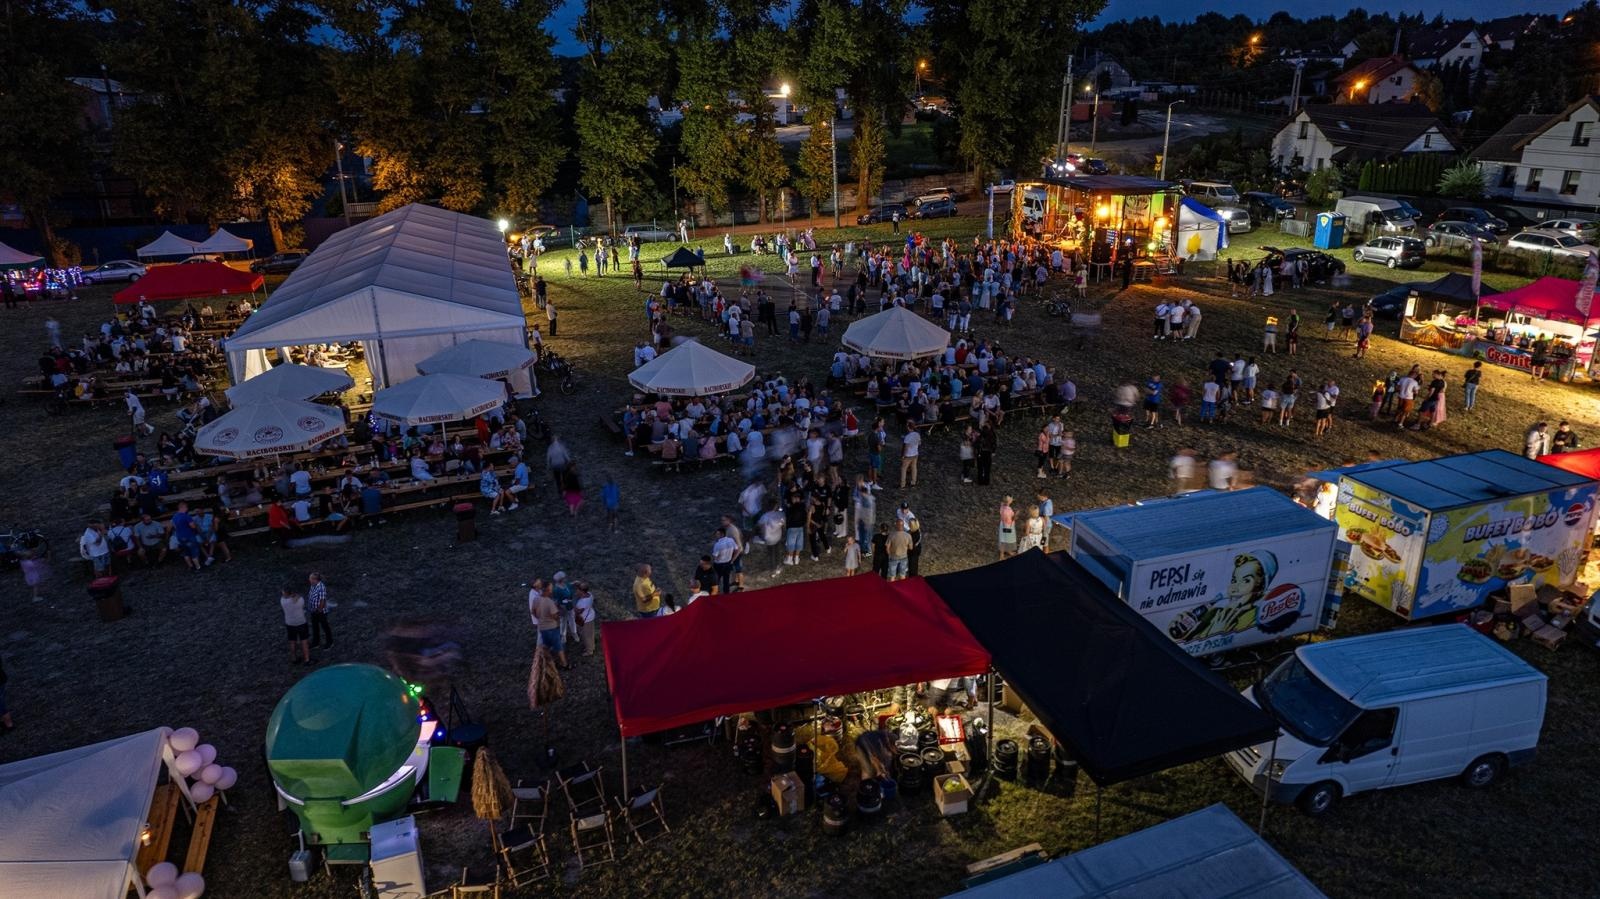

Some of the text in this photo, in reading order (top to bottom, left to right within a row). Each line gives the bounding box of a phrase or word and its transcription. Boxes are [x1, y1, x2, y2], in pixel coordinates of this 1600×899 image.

[418, 414, 454, 424] RACIBORSKIE
[307, 427, 341, 446] RACIBORSKIE
[246, 444, 296, 456] RACIBORSKIE
[1348, 502, 1411, 537] BUFET BOBO
[1464, 510, 1558, 542] BUFET BOBO
[1151, 563, 1206, 589] PEPSI się
[1139, 583, 1206, 611] nie odmawia
